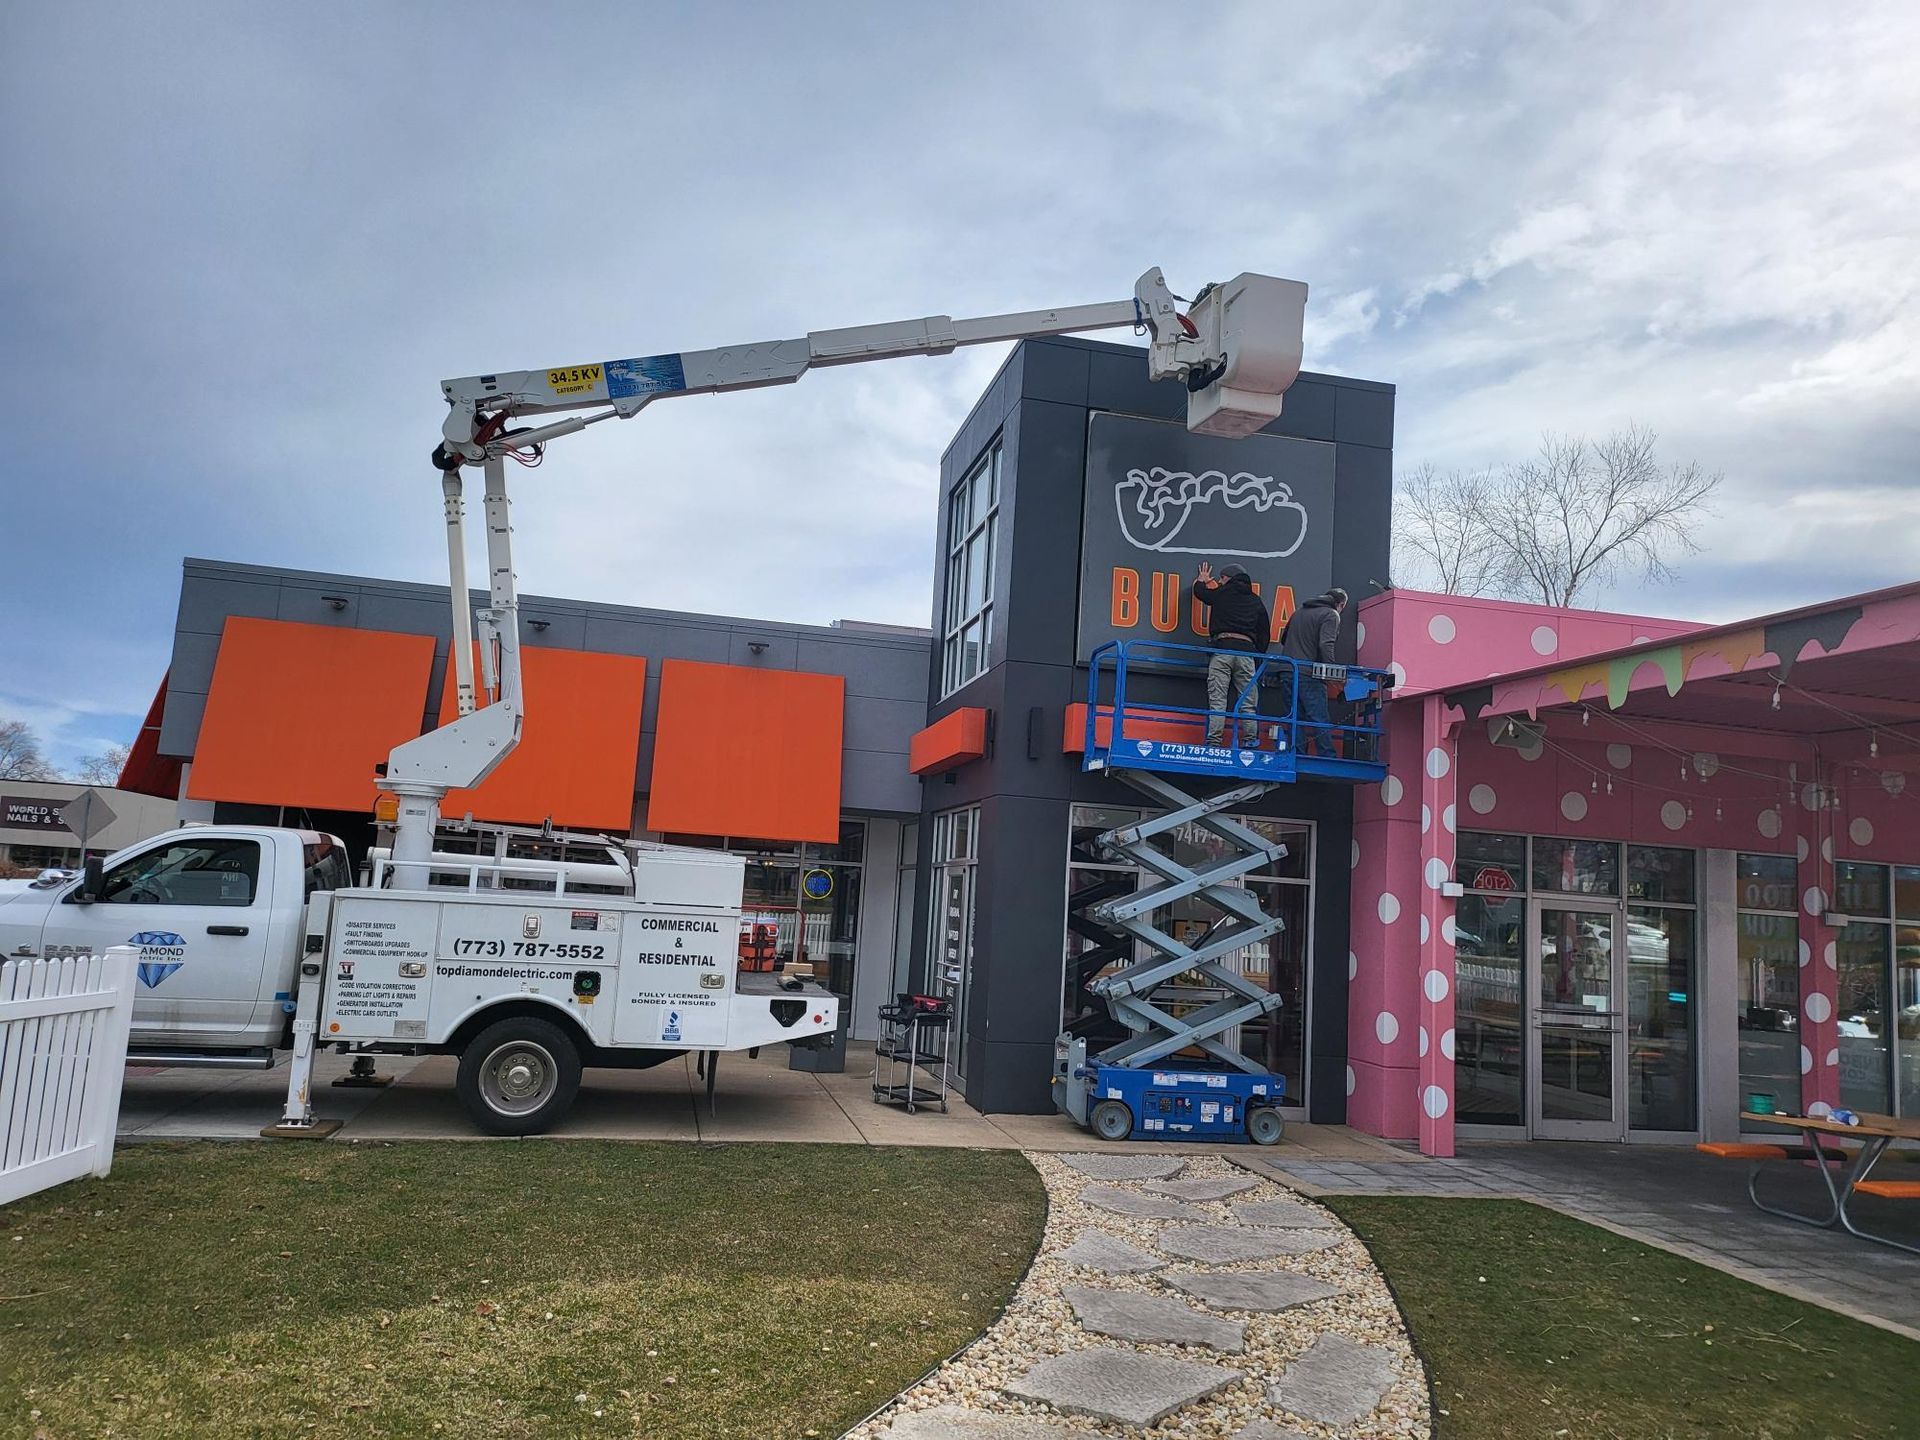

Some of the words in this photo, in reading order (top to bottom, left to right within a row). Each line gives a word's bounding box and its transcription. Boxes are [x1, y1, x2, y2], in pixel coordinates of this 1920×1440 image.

[551, 370, 578, 384] 34.5
[582, 367, 600, 379] KV
[556, 386, 584, 394] CATEGORY
[1111, 566, 1297, 644] BUA
[1161, 743, 1186, 755] (773)
[1189, 746, 1232, 758] 787-5552
[9, 804, 48, 815] WORLD
[7, 813, 38, 823] NAILS
[44, 815, 51, 824] &
[348, 921, 372, 929] DISASTER
[373, 922, 396, 930] SERVICES
[641, 918, 719, 933] COMMERCIAL
[346, 939, 384, 947] SWITCHBOARDS
[385, 941, 410, 949] UPGRADES
[674, 937, 683, 948] &
[140, 946, 184, 956] AMOND
[378, 949, 406, 957] EQUIPMENT
[453, 938, 506, 958] (773)
[513, 942, 605, 960] 787-5552
[638, 952, 716, 967] RESIDENTIAL
[436, 964, 573, 980] topdiamondelectric.com
[355, 982, 381, 990] VIOLATION
[396, 992, 416, 1000] REPAIRS
